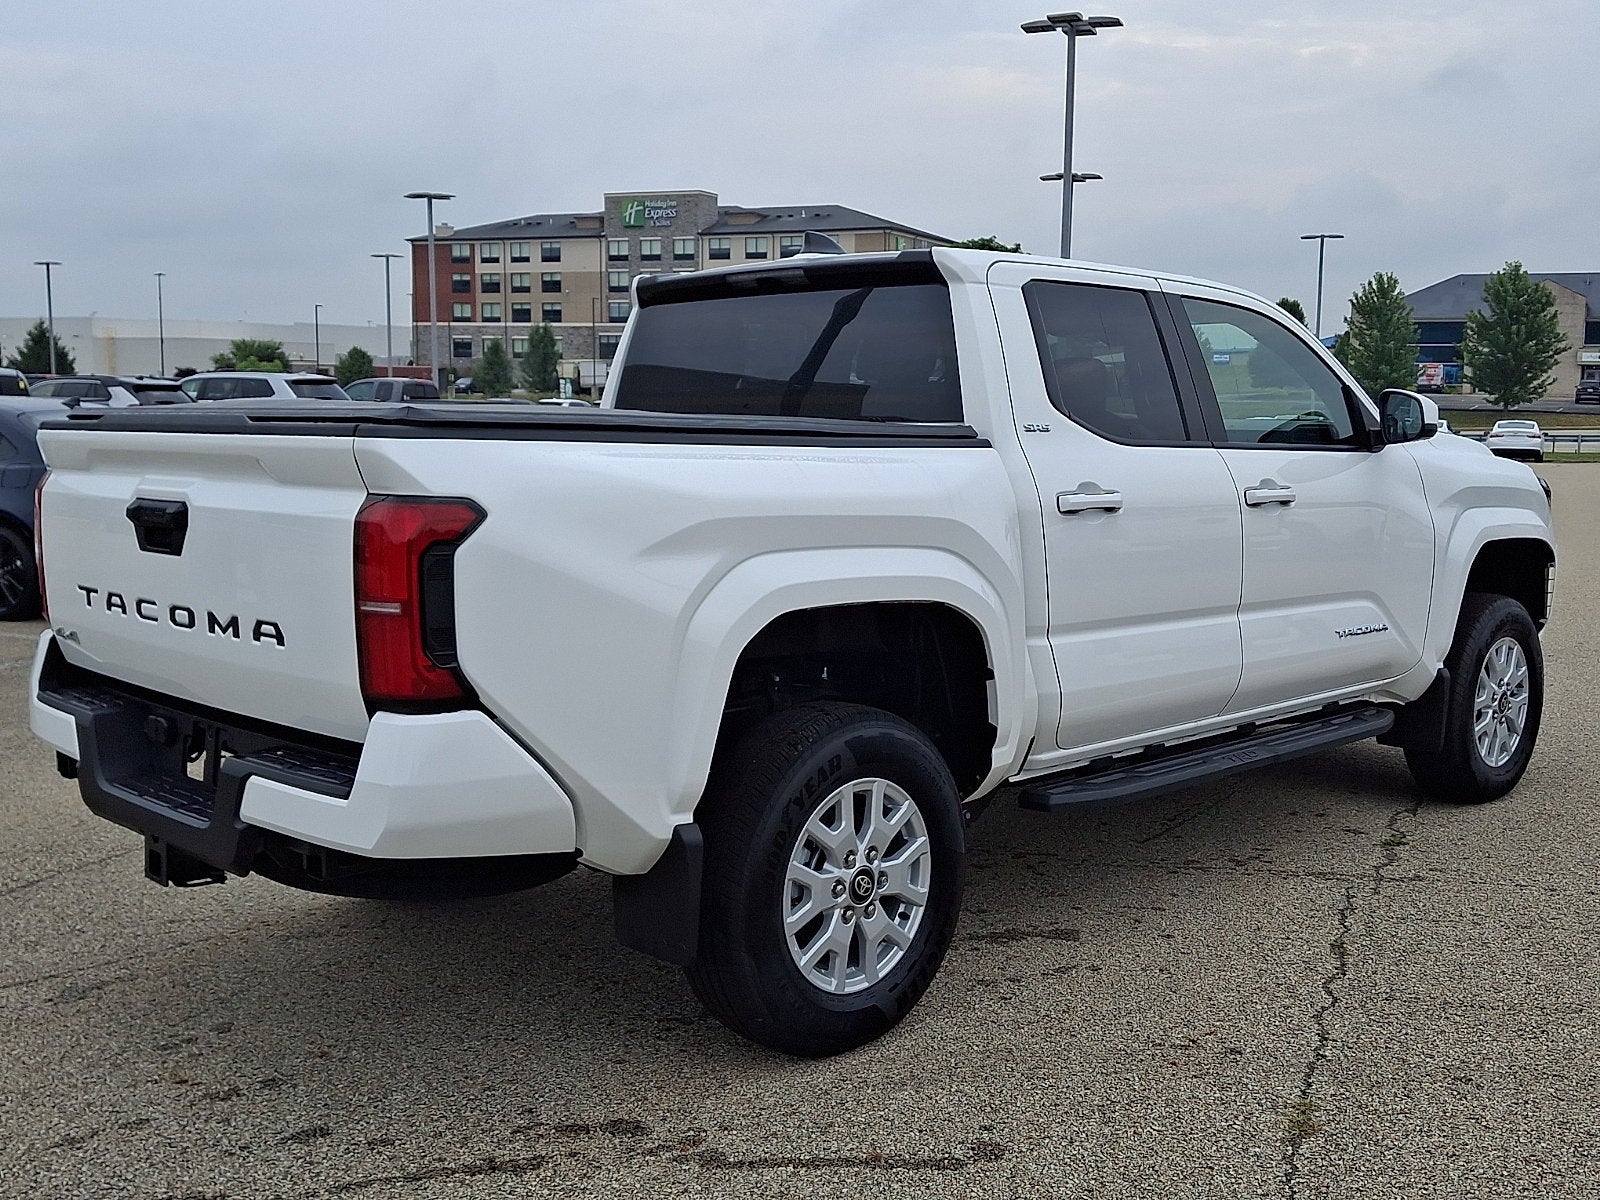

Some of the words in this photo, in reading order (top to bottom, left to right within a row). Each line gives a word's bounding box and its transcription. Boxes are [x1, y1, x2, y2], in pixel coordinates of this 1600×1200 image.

[645, 200, 667, 208] Holiday
[645, 208, 677, 219] Express
[77, 584, 286, 648] TACOMA
[1335, 623, 1389, 639] TACOMA
